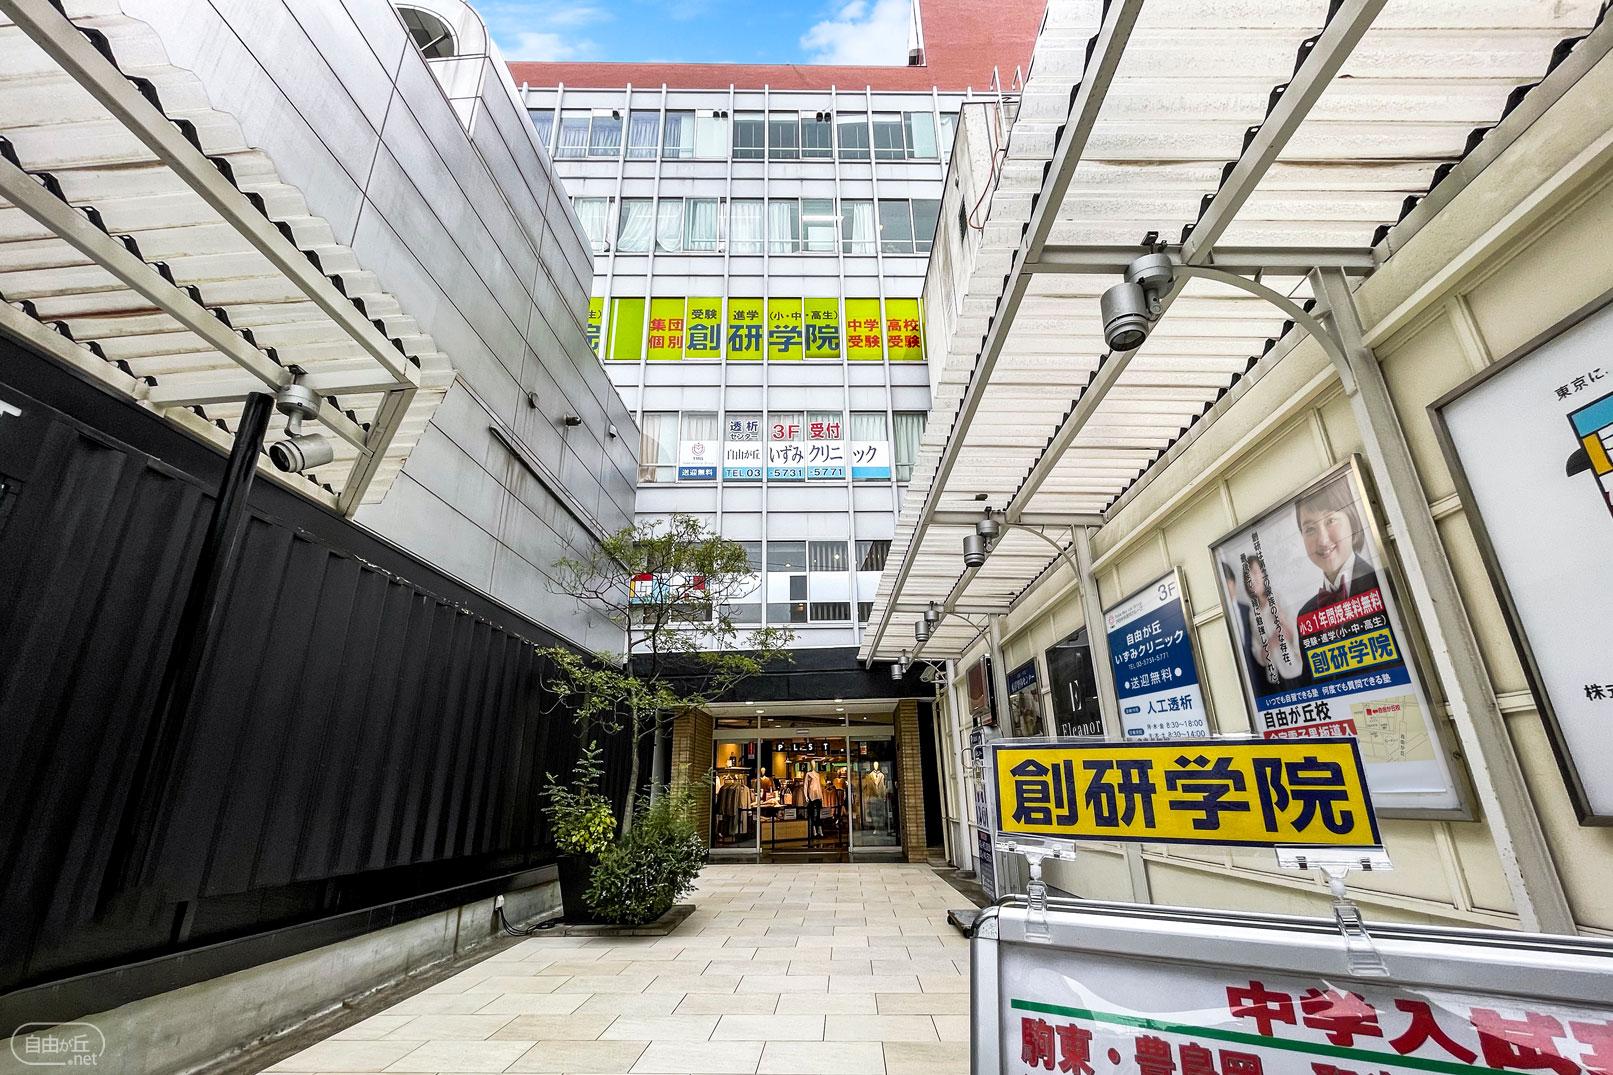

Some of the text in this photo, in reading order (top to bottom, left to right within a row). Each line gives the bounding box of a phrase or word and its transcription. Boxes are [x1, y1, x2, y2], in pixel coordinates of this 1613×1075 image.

[691, 309, 717, 319] 受験
[733, 310, 759, 321] 進学
[650, 318, 685, 331] 集団
[848, 318, 920, 332] 中学 高校
[649, 335, 683, 349] 個別
[687, 323, 840, 352] 創研学院
[848, 334, 920, 348] 受験 受験
[730, 421, 758, 431] 透析
[772, 422, 840, 439] 3F 受付
[769, 445, 877, 464] いずみクリニック
[727, 469, 744, 477] TEL
[1158, 581, 1176, 601] 3F
[1126, 620, 1162, 646] 自由が丘
[1311, 634, 1394, 674] 創研学院
[1130, 667, 1173, 690] 送迎無料
[1147, 694, 1192, 714] 人工透析
[1263, 701, 1332, 729] 自由が丘校
[1062, 720, 1101, 737] Eleanor
[1011, 755, 1354, 834] 創研学院
